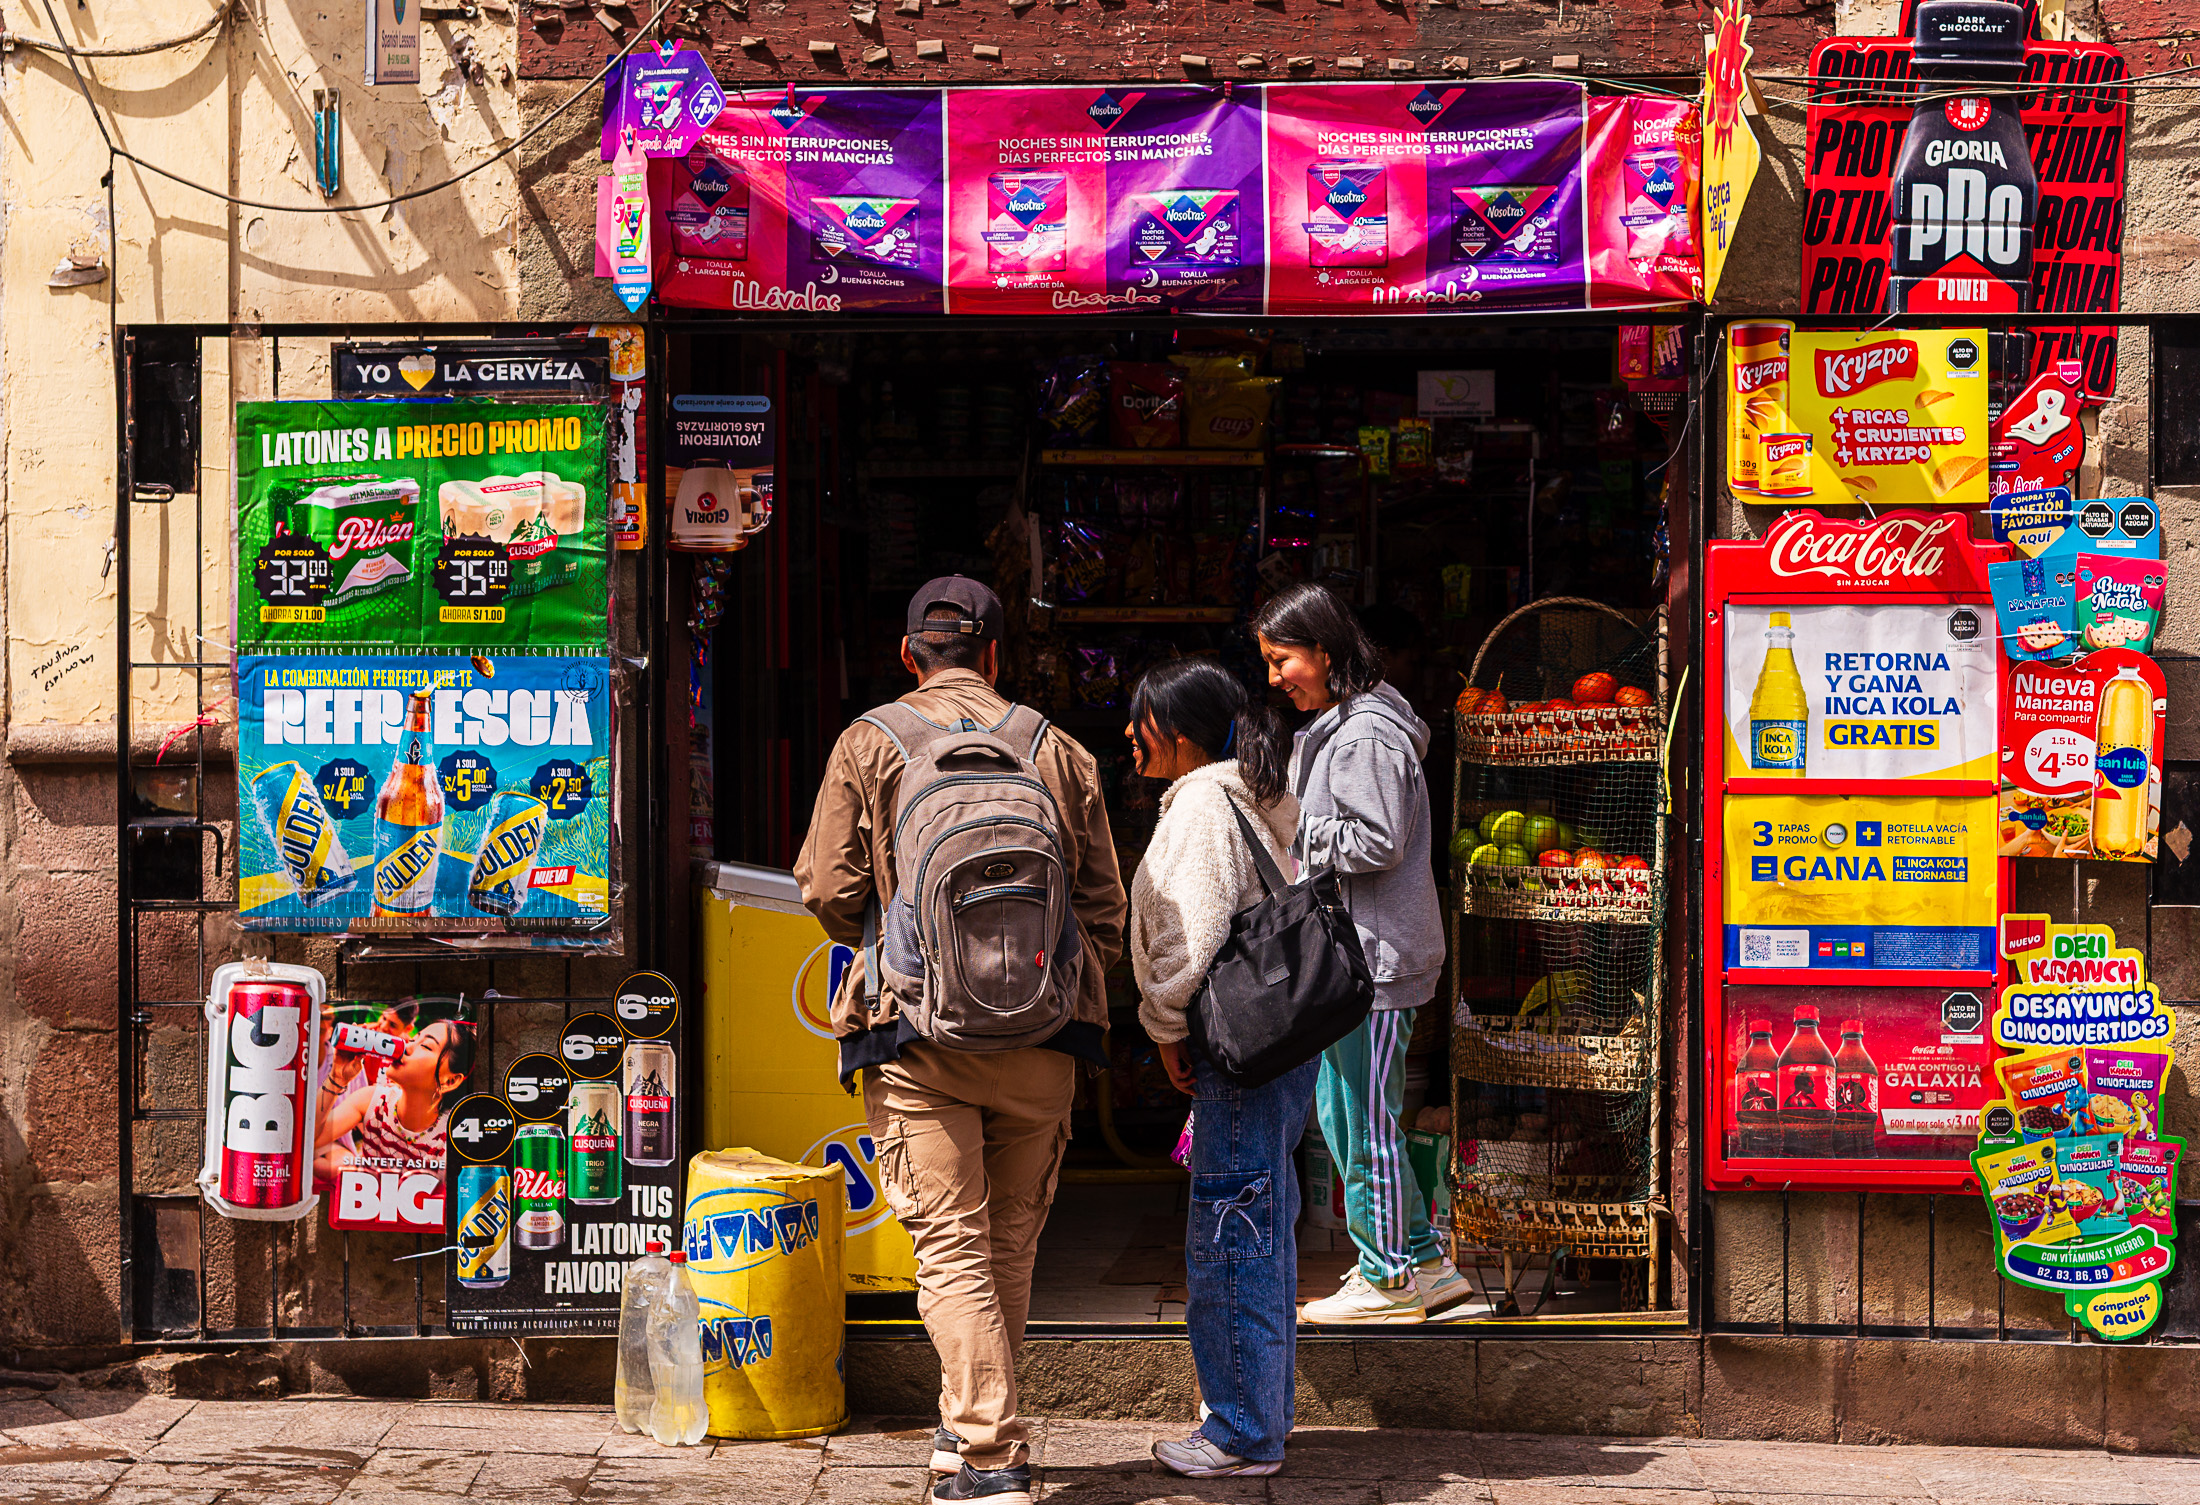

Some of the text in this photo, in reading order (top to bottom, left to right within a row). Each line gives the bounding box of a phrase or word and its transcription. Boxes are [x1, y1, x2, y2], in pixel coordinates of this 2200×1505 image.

[1939, 24, 2003, 33] CHOCOLATE
[1957, 16, 1986, 25] DARK
[1089, 105, 1123, 116] Nosotras
[1961, 98, 1976, 119] 30
[999, 131, 1213, 150] NOCHES SIN INTERRUPCIONES,
[715, 147, 894, 165] PERFECTOS SIN MANCHAS
[999, 144, 1213, 164] DÍAS PERFECTOS SIN MANCHAS
[1925, 140, 2008, 170] GLORIA
[692, 179, 731, 193] Nosotras
[1707, 181, 1731, 207] Cerca
[1008, 198, 1047, 213] Nosotras
[845, 214, 887, 229] Nosotras
[1166, 208, 1207, 222] Nosotras
[1710, 212, 1718, 233] de
[1718, 212, 1727, 251] ti
[841, 277, 905, 287] BUENAS NOCHES
[1937, 279, 1988, 301] POWER
[356, 361, 586, 384] YO LA CERVEZA
[1737, 361, 1787, 391] Kryzpo
[1824, 346, 1909, 393] Kryzpo
[676, 421, 765, 432] LAS GLORITAZAS
[1852, 411, 1909, 425] RICAS
[262, 416, 581, 468] LATONES A PRECIO PROMO
[679, 432, 762, 446] ¡VOLVIERON!
[1854, 427, 1966, 443] CRUJIENTES
[1856, 446, 1932, 461] KRYZPO
[2053, 444, 2074, 464] 28 cm
[2010, 491, 2056, 504] COMPRA TU
[685, 507, 730, 524] GLORIA
[2001, 513, 2064, 529] FAVORITO
[328, 516, 415, 561] Pilsen
[509, 536, 554, 557] CUSQUEÑA
[2018, 530, 2052, 546] AQUÍ
[275, 549, 315, 557] POR SOLO
[454, 549, 495, 557] POR SOLO
[1770, 519, 1956, 577] Coca-Cola
[1836, 578, 1890, 587] SIN AZÚCAR
[2091, 593, 2148, 613] Natale!
[1825, 652, 1951, 671] RETORNA
[264, 667, 473, 688] LA COMBINACIÓN PERFECTA QUE TE
[1825, 675, 1923, 693] Y GANA
[2015, 673, 2095, 697] Nueva
[1825, 697, 1962, 715] INCA KOLA
[2015, 695, 2094, 712] Manzana
[2014, 711, 2092, 724] Para compartir
[1765, 733, 1792, 743] INCA
[1829, 724, 1936, 746] GRATIS
[1764, 744, 1793, 754] KOLA
[2030, 747, 2089, 779] S/ 4.50
[2098, 757, 2147, 770] san luis
[1753, 821, 1969, 847] 3 TAPAS BOTELLA VACÍA
[1778, 835, 1956, 845] PROMO RETORNABLE
[375, 832, 439, 898] GOLDEN
[1783, 855, 1887, 882] GANA
[1895, 859, 1966, 869] 1L INCA KOLA
[533, 868, 569, 885] NUEVA
[1895, 870, 1967, 881] RETORNABLE
[2009, 934, 2042, 949] NUEVO
[2054, 935, 2107, 959] DELI
[2030, 959, 2138, 984] KRANCH
[1949, 1005, 1964, 1013] ALTO
[1949, 1011, 1976, 1019] AZÚCAR
[2013, 993, 2152, 1019] DESAYUNOS
[2003, 1016, 2169, 1043] DINODIVERTIDOS
[344, 1027, 397, 1056] BIG
[1885, 1064, 1981, 1073] LLEVA CONTIGO LA
[226, 1005, 301, 1154] BIG
[1885, 1073, 1982, 1088] GALAXIA
[2021, 1077, 2080, 1100] DINOCHOKO
[2096, 1077, 2154, 1089] DINOFLAKES
[629, 1098, 669, 1112] CUSQUEÑA
[1890, 1119, 1904, 1129] 600
[1905, 1119, 1916, 1128] ml
[1916, 1121, 1929, 1131] por
[1930, 1120, 1945, 1129] solo
[573, 1135, 616, 1151] CUSQUEÑA
[254, 1165, 291, 1178] 355 mL
[2059, 1159, 2115, 1173] DINOZUKAR
[339, 1171, 444, 1226] BIG
[628, 1185, 673, 1218] TUS
[571, 1222, 672, 1257] LATONES
[2041, 1235, 2146, 1264] CON VITAMINAS Y HIERRO
[2037, 1254, 2157, 1282] B2, B3, B6, B9 C Fe
[2093, 1293, 2151, 1313] cómpralos
[2102, 1304, 2146, 1327] AQUÍ
